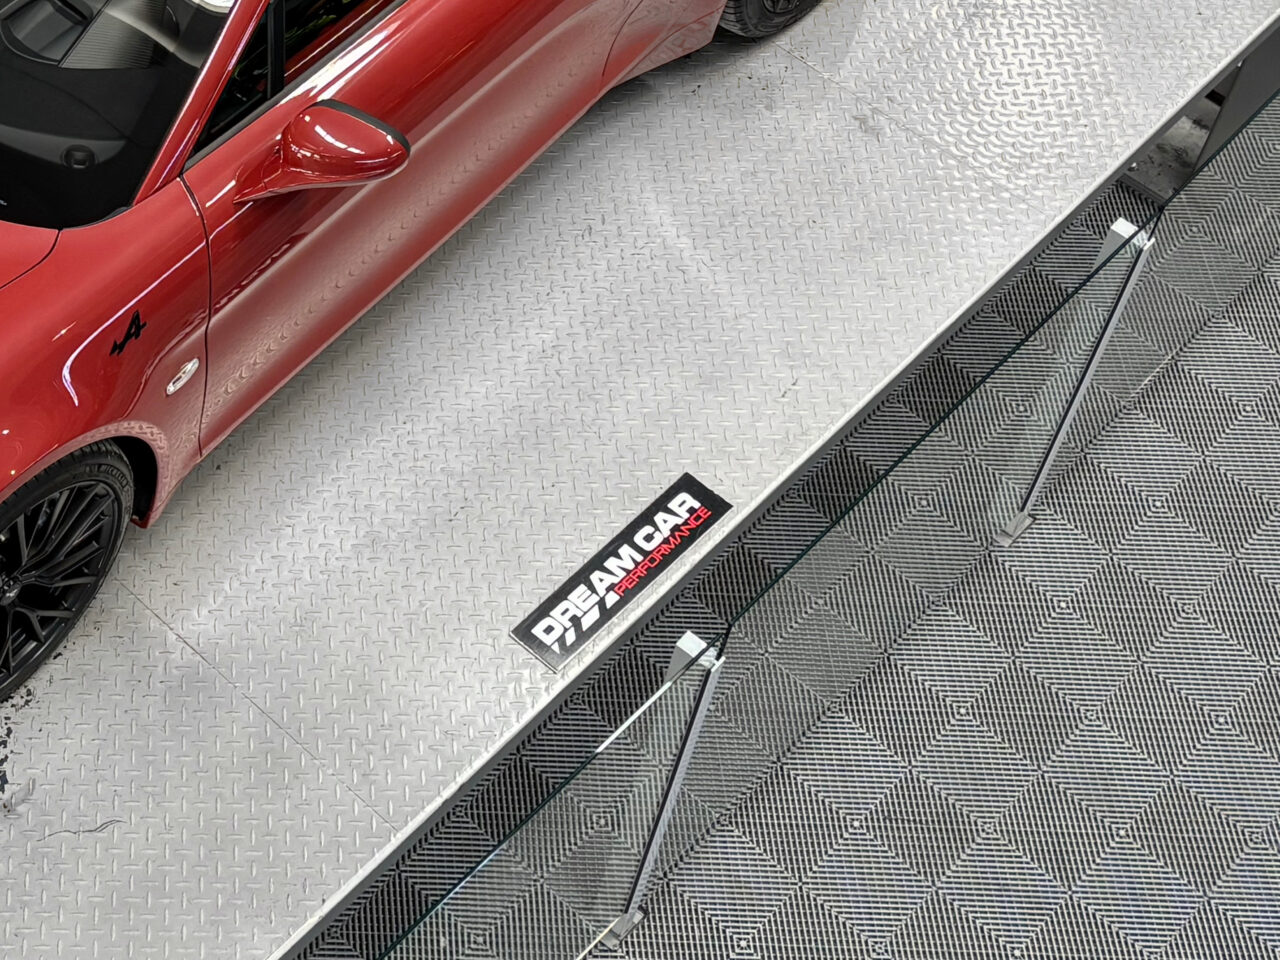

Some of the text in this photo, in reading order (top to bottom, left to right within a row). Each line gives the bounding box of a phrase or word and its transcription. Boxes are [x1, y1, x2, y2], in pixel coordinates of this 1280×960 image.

[531, 492, 701, 646] DREAM CAR
[614, 506, 712, 597] PERFORMANCE
